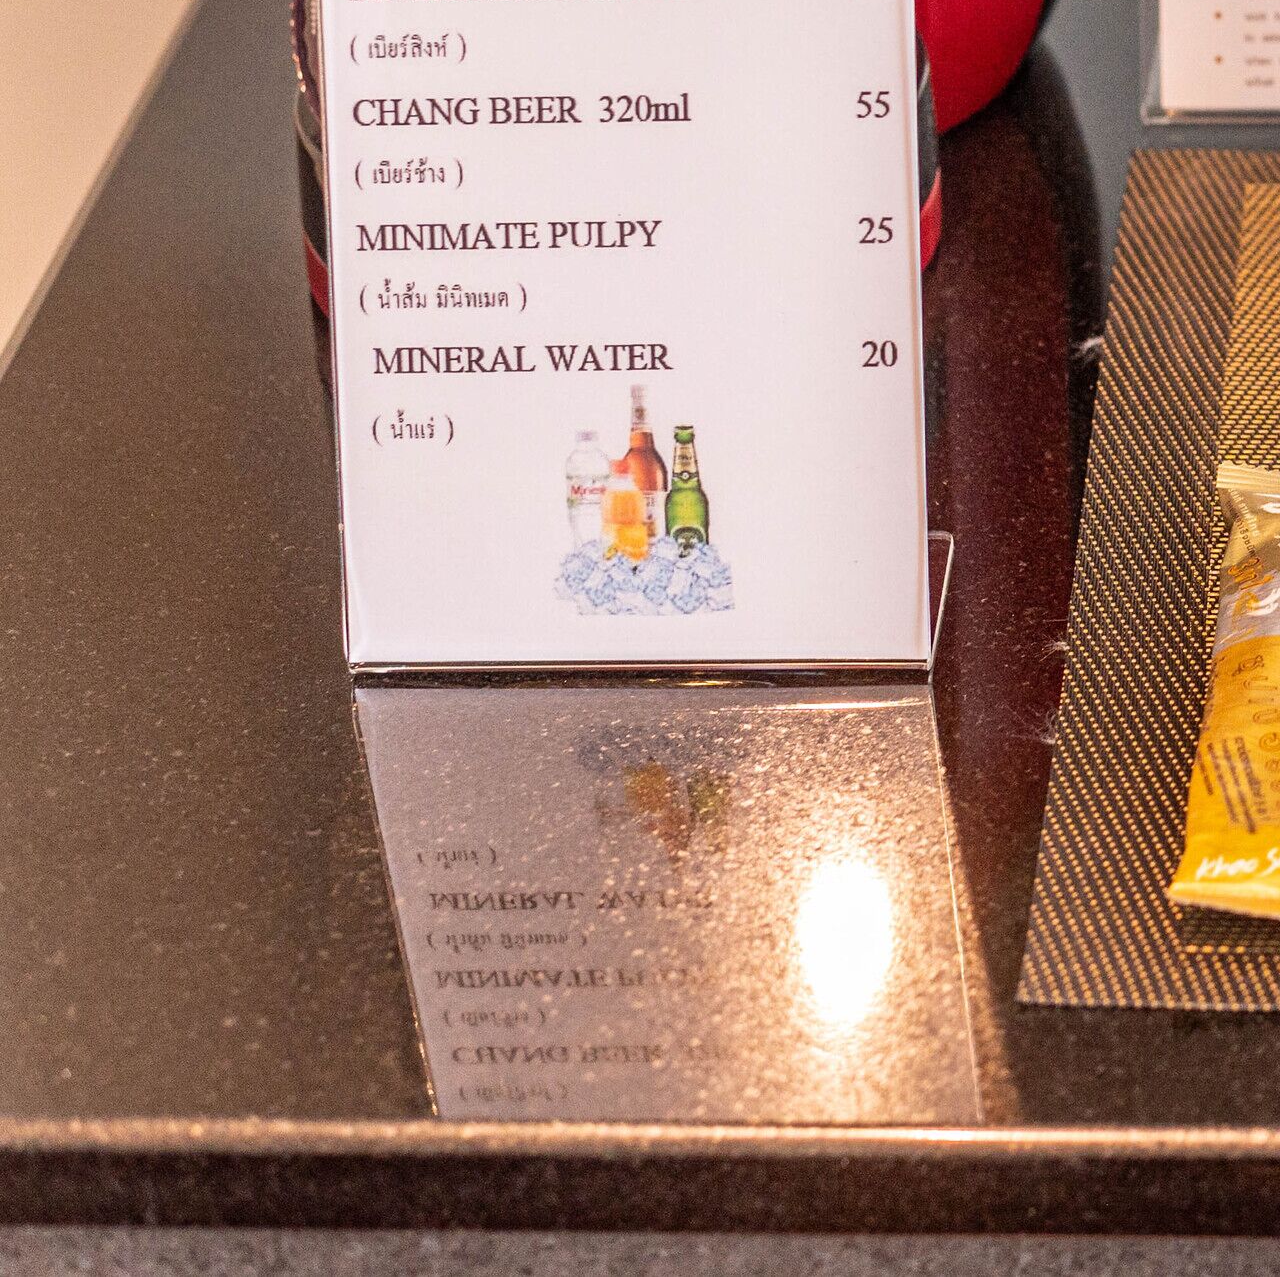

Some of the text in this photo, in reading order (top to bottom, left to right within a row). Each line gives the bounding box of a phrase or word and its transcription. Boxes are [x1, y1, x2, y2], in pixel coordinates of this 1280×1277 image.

[352, 90, 890, 126] CHANG BEER 320ml 55
[355, 216, 894, 252] MINIMATE PULPY 25
[373, 340, 898, 374] MINERAL WATER 20
